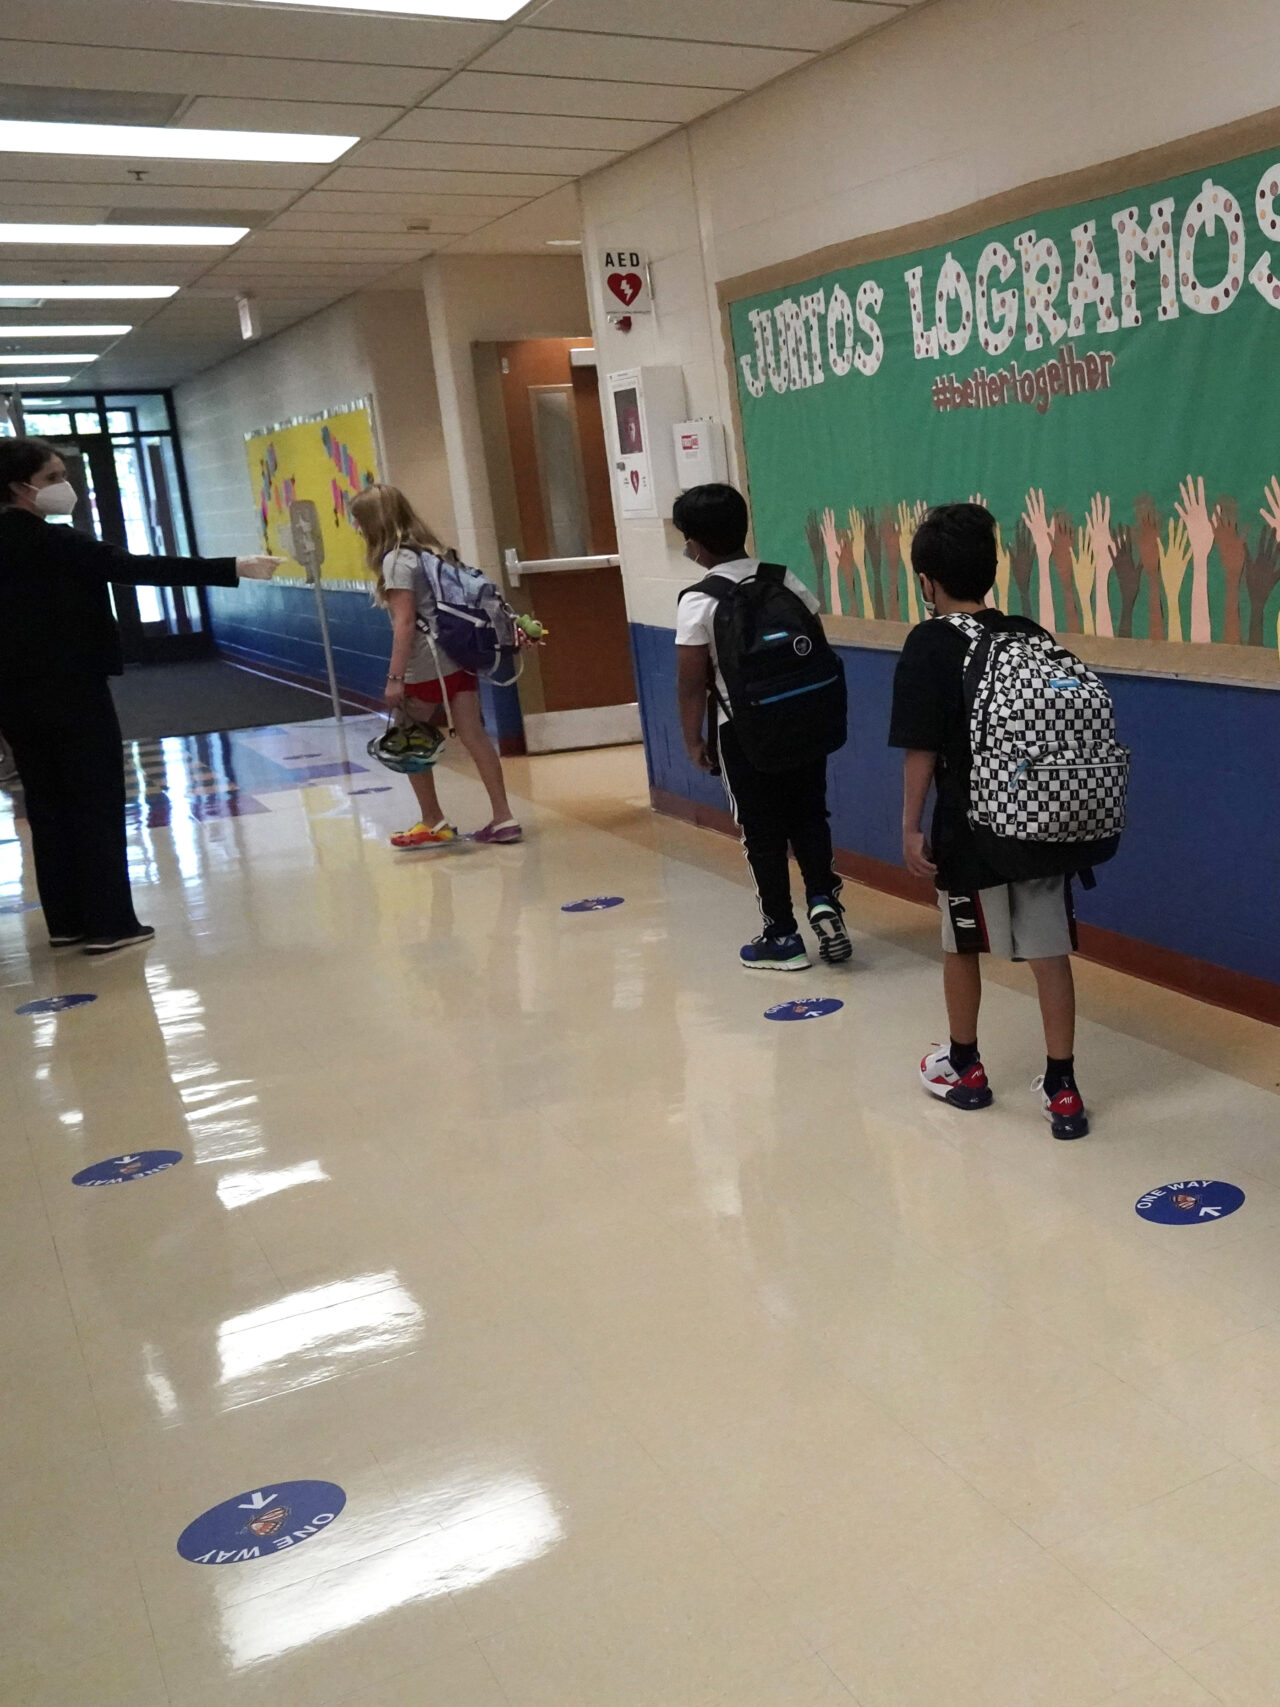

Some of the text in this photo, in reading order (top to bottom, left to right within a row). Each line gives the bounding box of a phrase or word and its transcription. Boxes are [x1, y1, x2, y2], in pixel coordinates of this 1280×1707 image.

[605, 252, 640, 267] AED
[740, 280, 884, 398] JUNTOS
[1137, 1181, 1213, 1209] ONE WAY
[194, 1513, 334, 1563] ONE WAY
